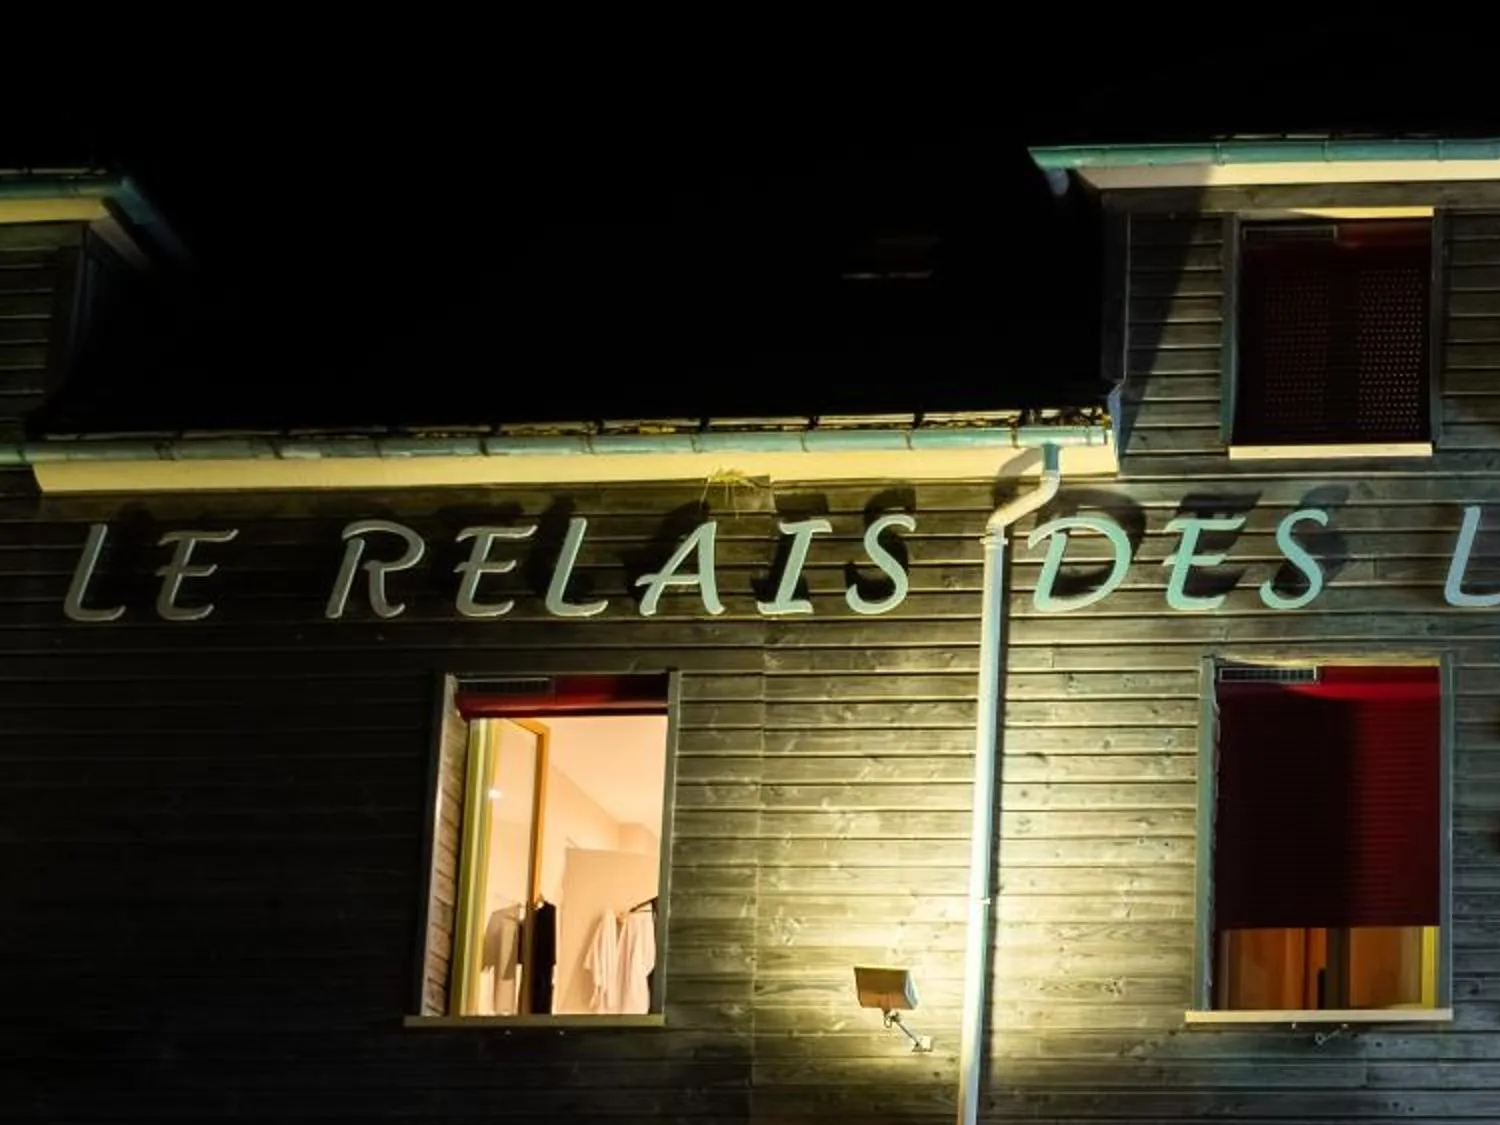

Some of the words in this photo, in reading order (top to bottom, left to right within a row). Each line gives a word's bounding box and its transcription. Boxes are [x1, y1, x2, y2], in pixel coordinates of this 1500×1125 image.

[63, 522, 239, 622] LE
[325, 514, 917, 620] RELAIS
[1027, 508, 1330, 612] DES
